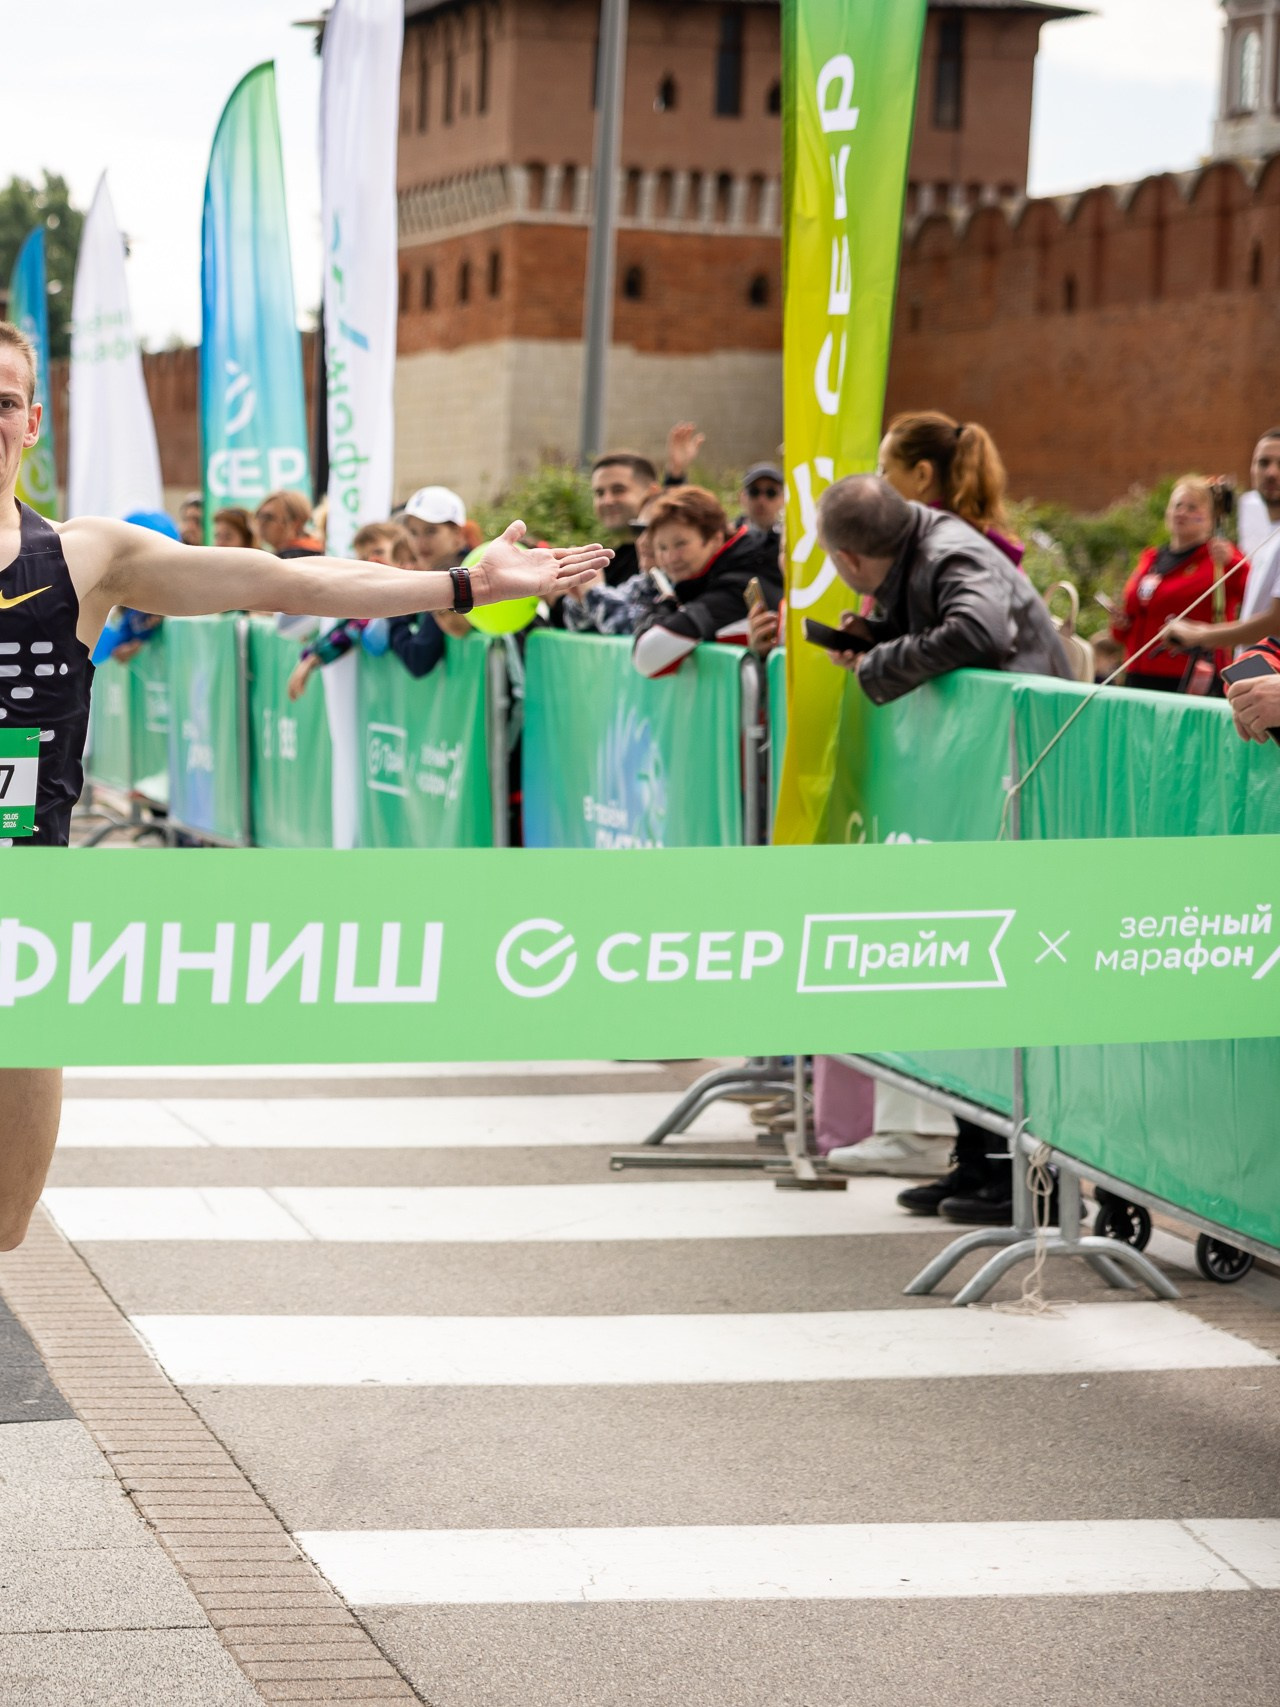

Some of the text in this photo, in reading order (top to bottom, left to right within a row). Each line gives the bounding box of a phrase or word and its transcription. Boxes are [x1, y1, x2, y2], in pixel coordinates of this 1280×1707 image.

[206, 446, 307, 498] СЕР
[2, 813, 19, 821] 30.05
[2, 821, 17, 829] 2026
[1119, 903, 1273, 939] зелёный
[596, 930, 970, 983] СБЕР Прайм
[1094, 938, 1255, 976] марафон
